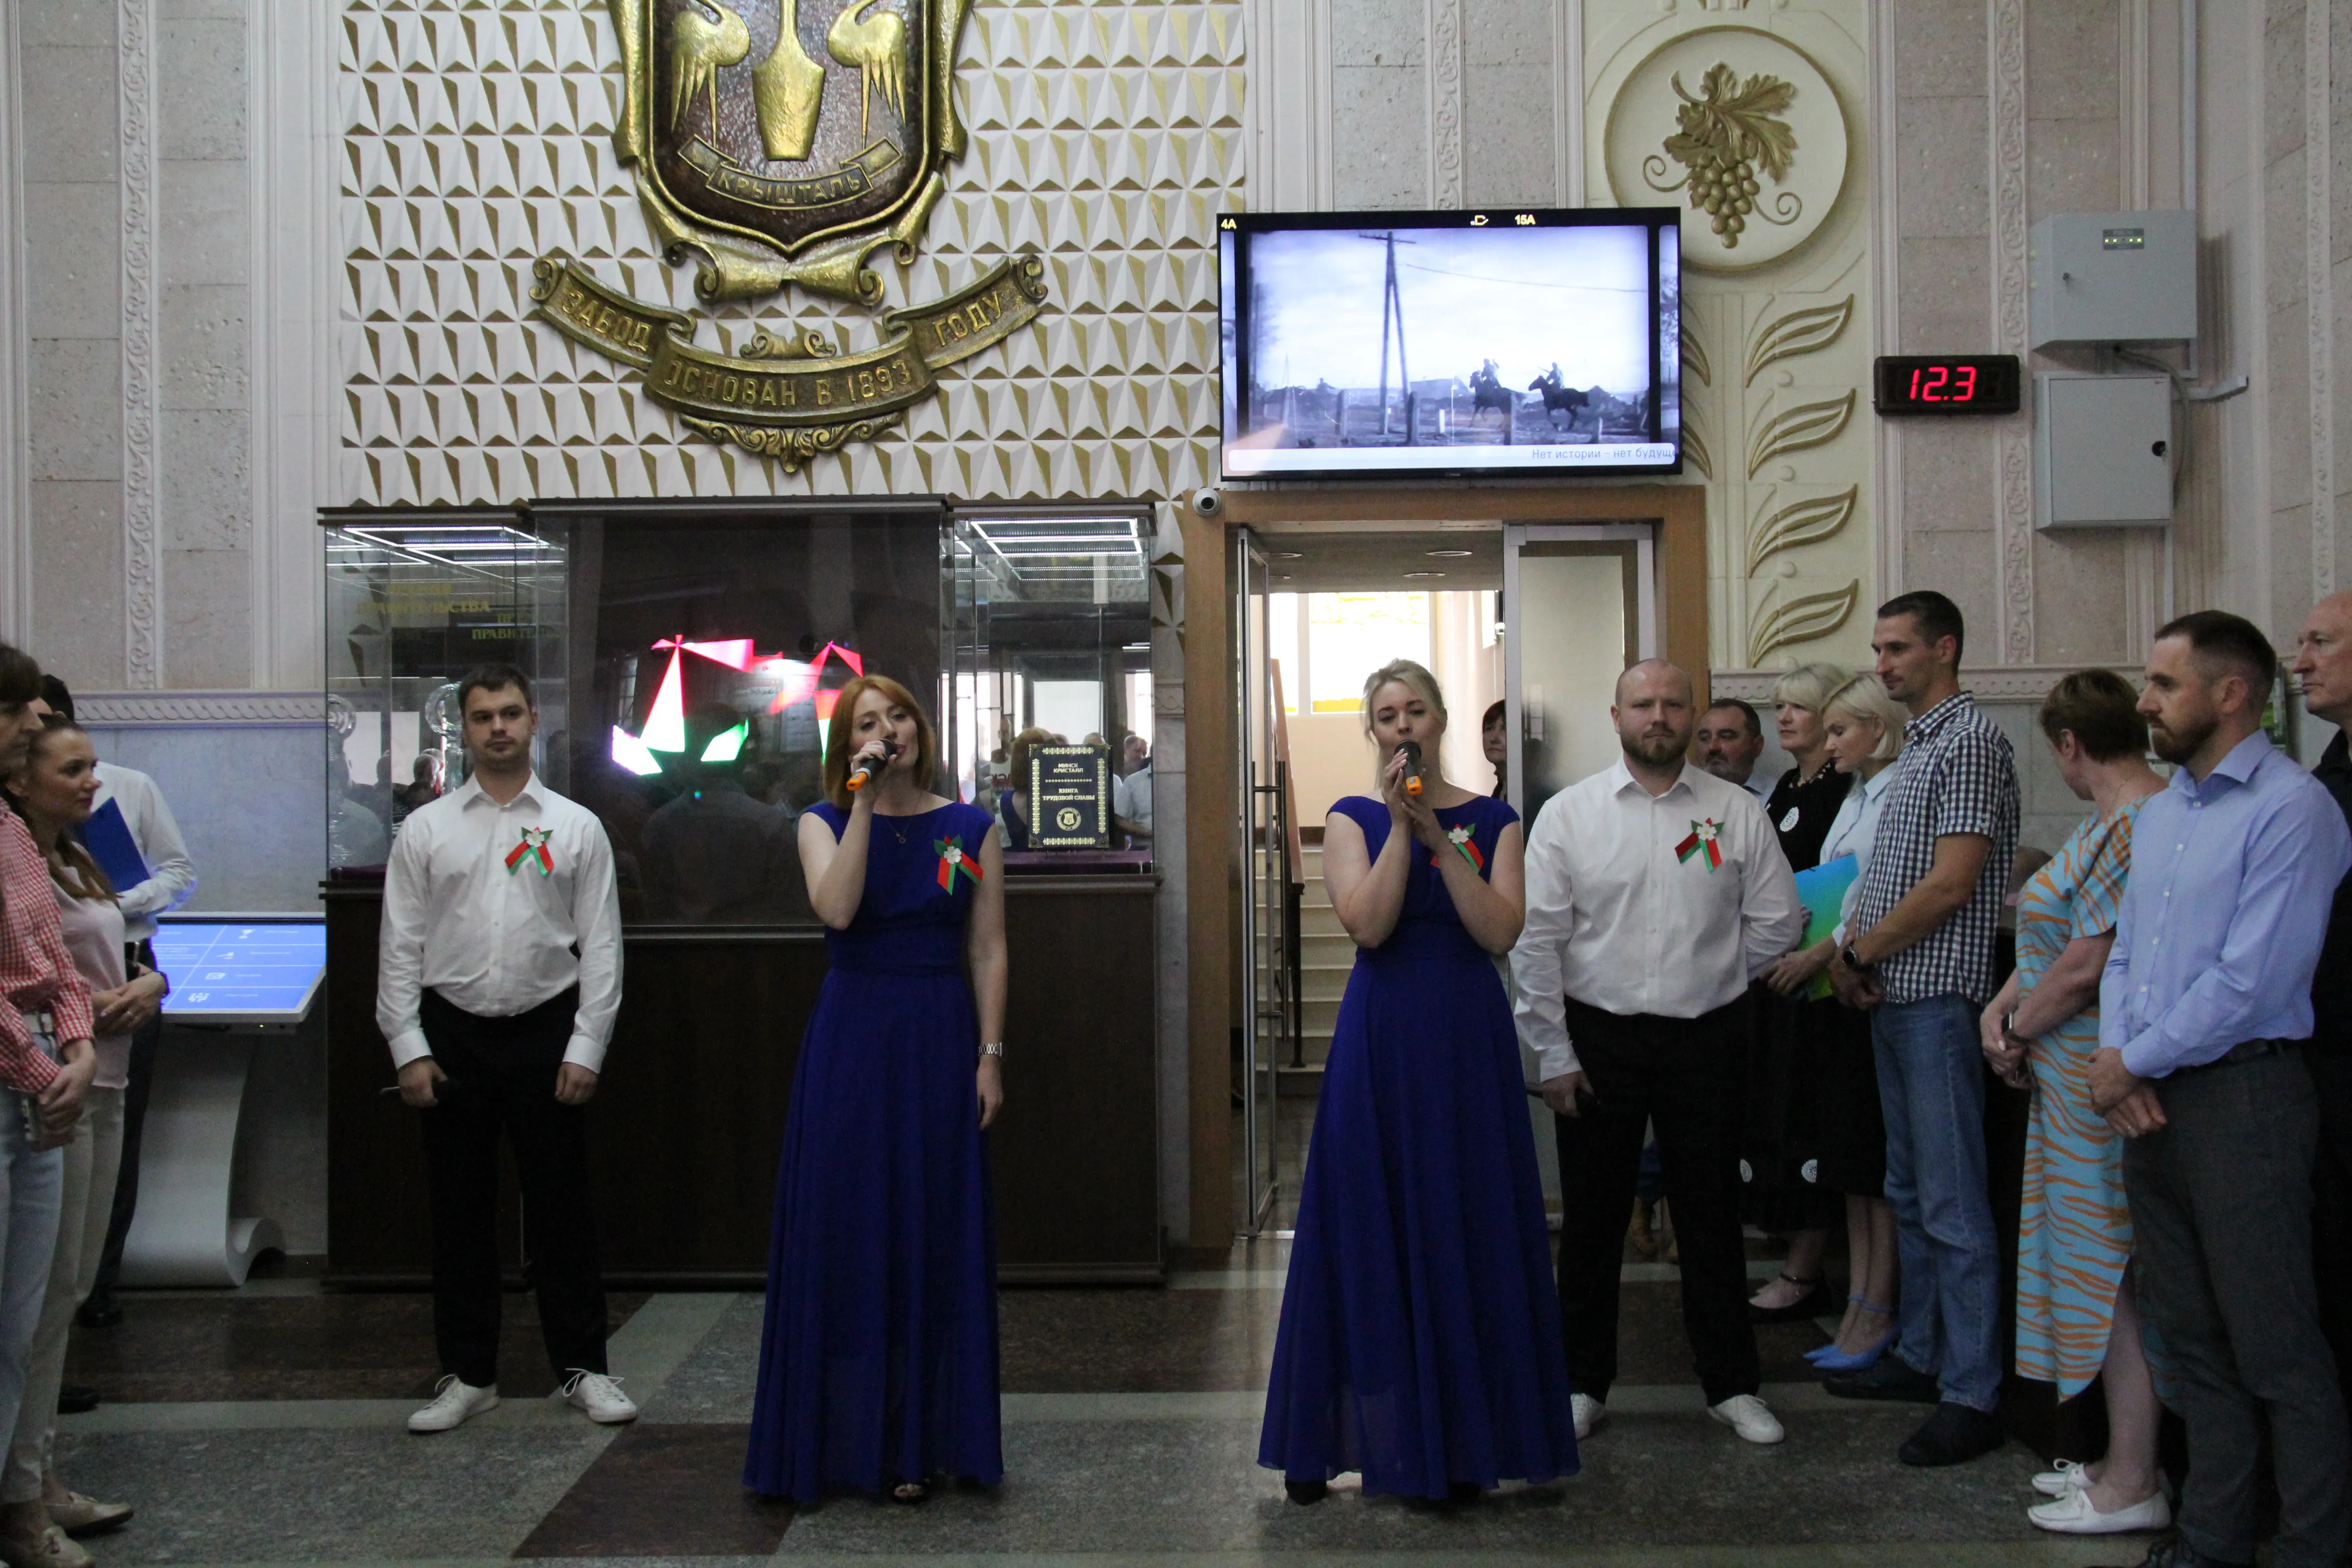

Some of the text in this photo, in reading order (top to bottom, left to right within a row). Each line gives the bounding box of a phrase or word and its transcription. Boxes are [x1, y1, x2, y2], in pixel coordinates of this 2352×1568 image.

[717, 172, 860, 204] КРЫШТАЛЬ
[1221, 219, 1237, 229] 4A
[1515, 214, 1536, 225] 15A
[932, 290, 1001, 346] ГОДУ
[664, 358, 912, 405] ОСНОВАН В 1893
[1910, 367, 1977, 401] 12.3
[1533, 449, 1552, 459] Нет
[1556, 449, 1601, 460] истории
